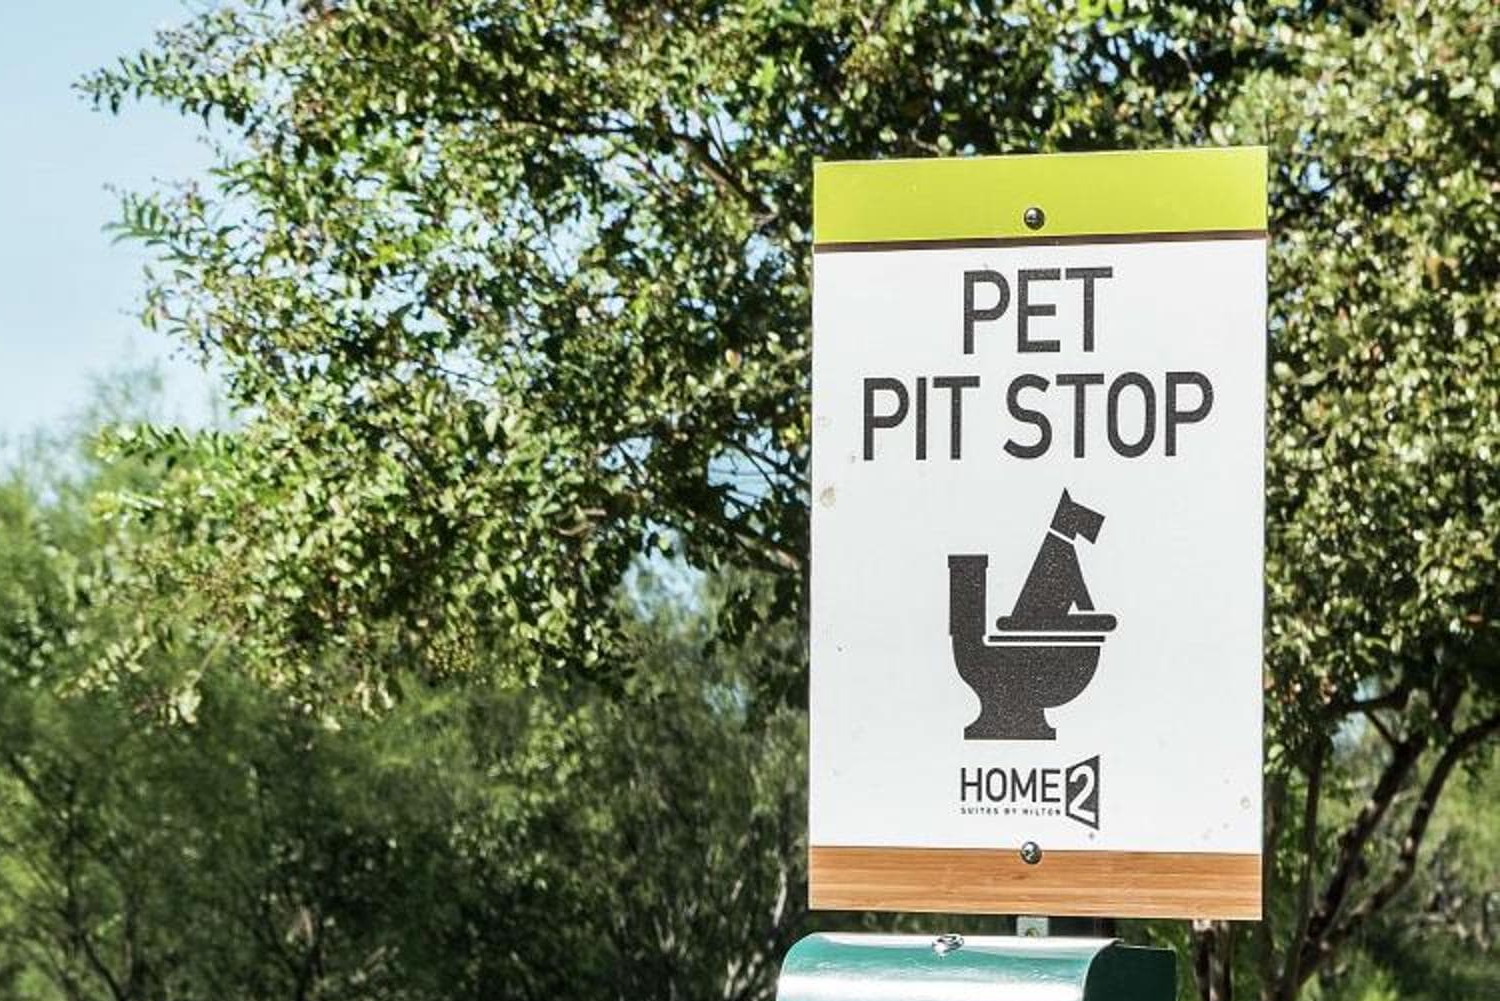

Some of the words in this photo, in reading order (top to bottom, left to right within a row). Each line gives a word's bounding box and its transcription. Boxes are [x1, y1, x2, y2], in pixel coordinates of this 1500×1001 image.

[963, 266, 1113, 355] PET
[862, 375, 981, 461] PIT
[1003, 371, 1215, 460] STOP
